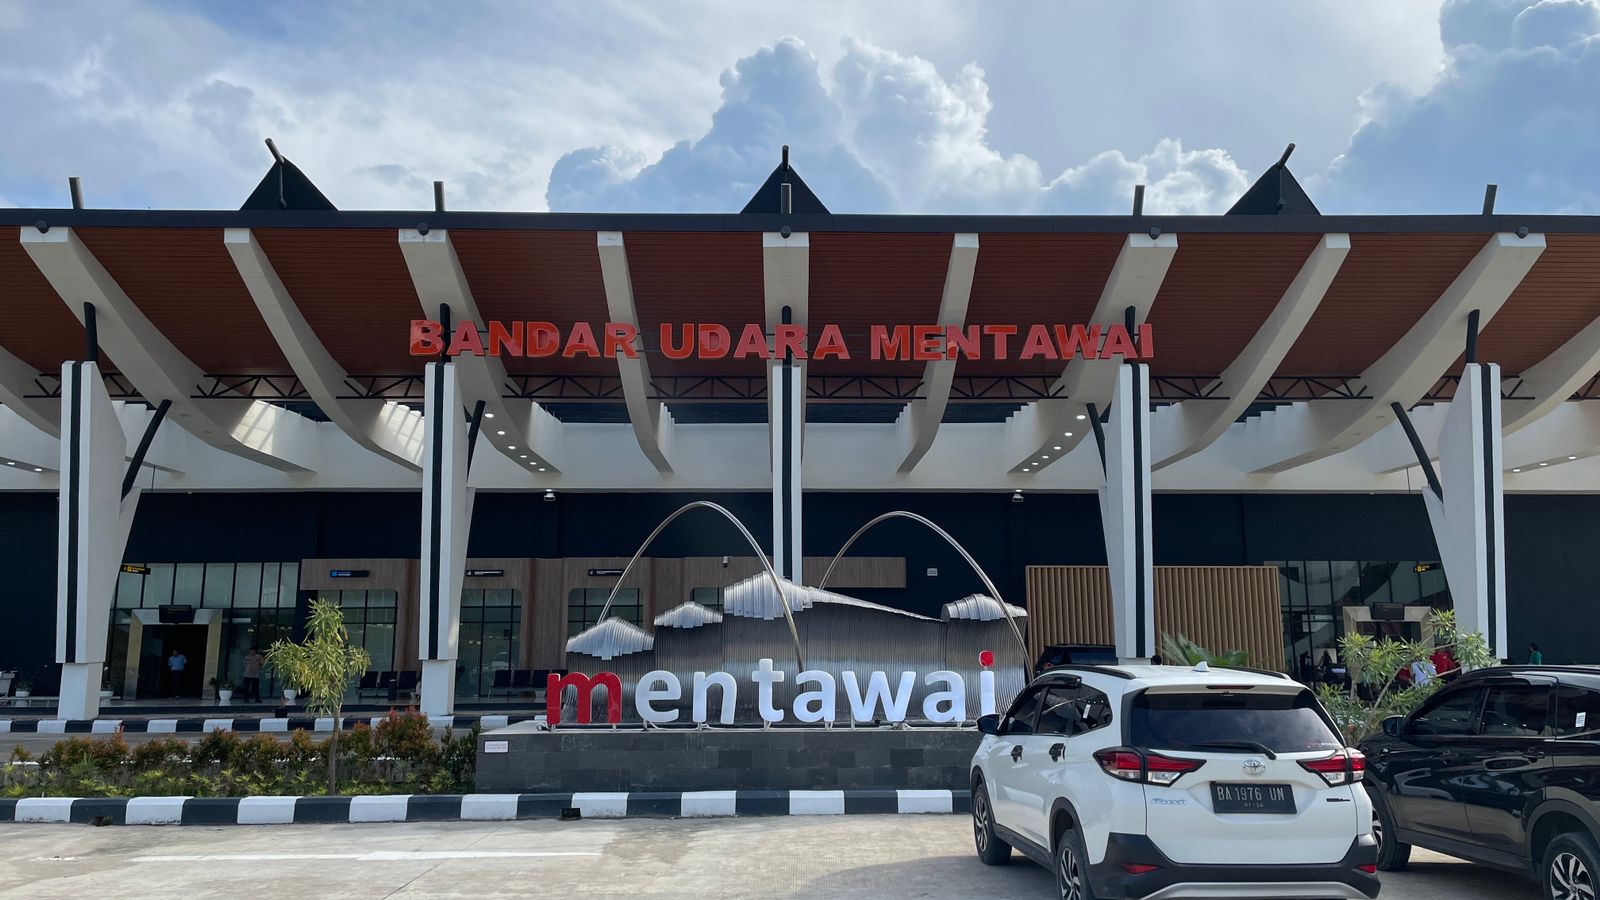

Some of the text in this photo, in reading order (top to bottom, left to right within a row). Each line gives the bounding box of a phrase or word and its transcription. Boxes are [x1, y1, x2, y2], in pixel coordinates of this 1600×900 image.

[409, 320, 1154, 360] BANDAR UDARA MENTAWAI
[547, 650, 996, 724] mentawai
[1217, 786, 1284, 801] BA 1976 UN
